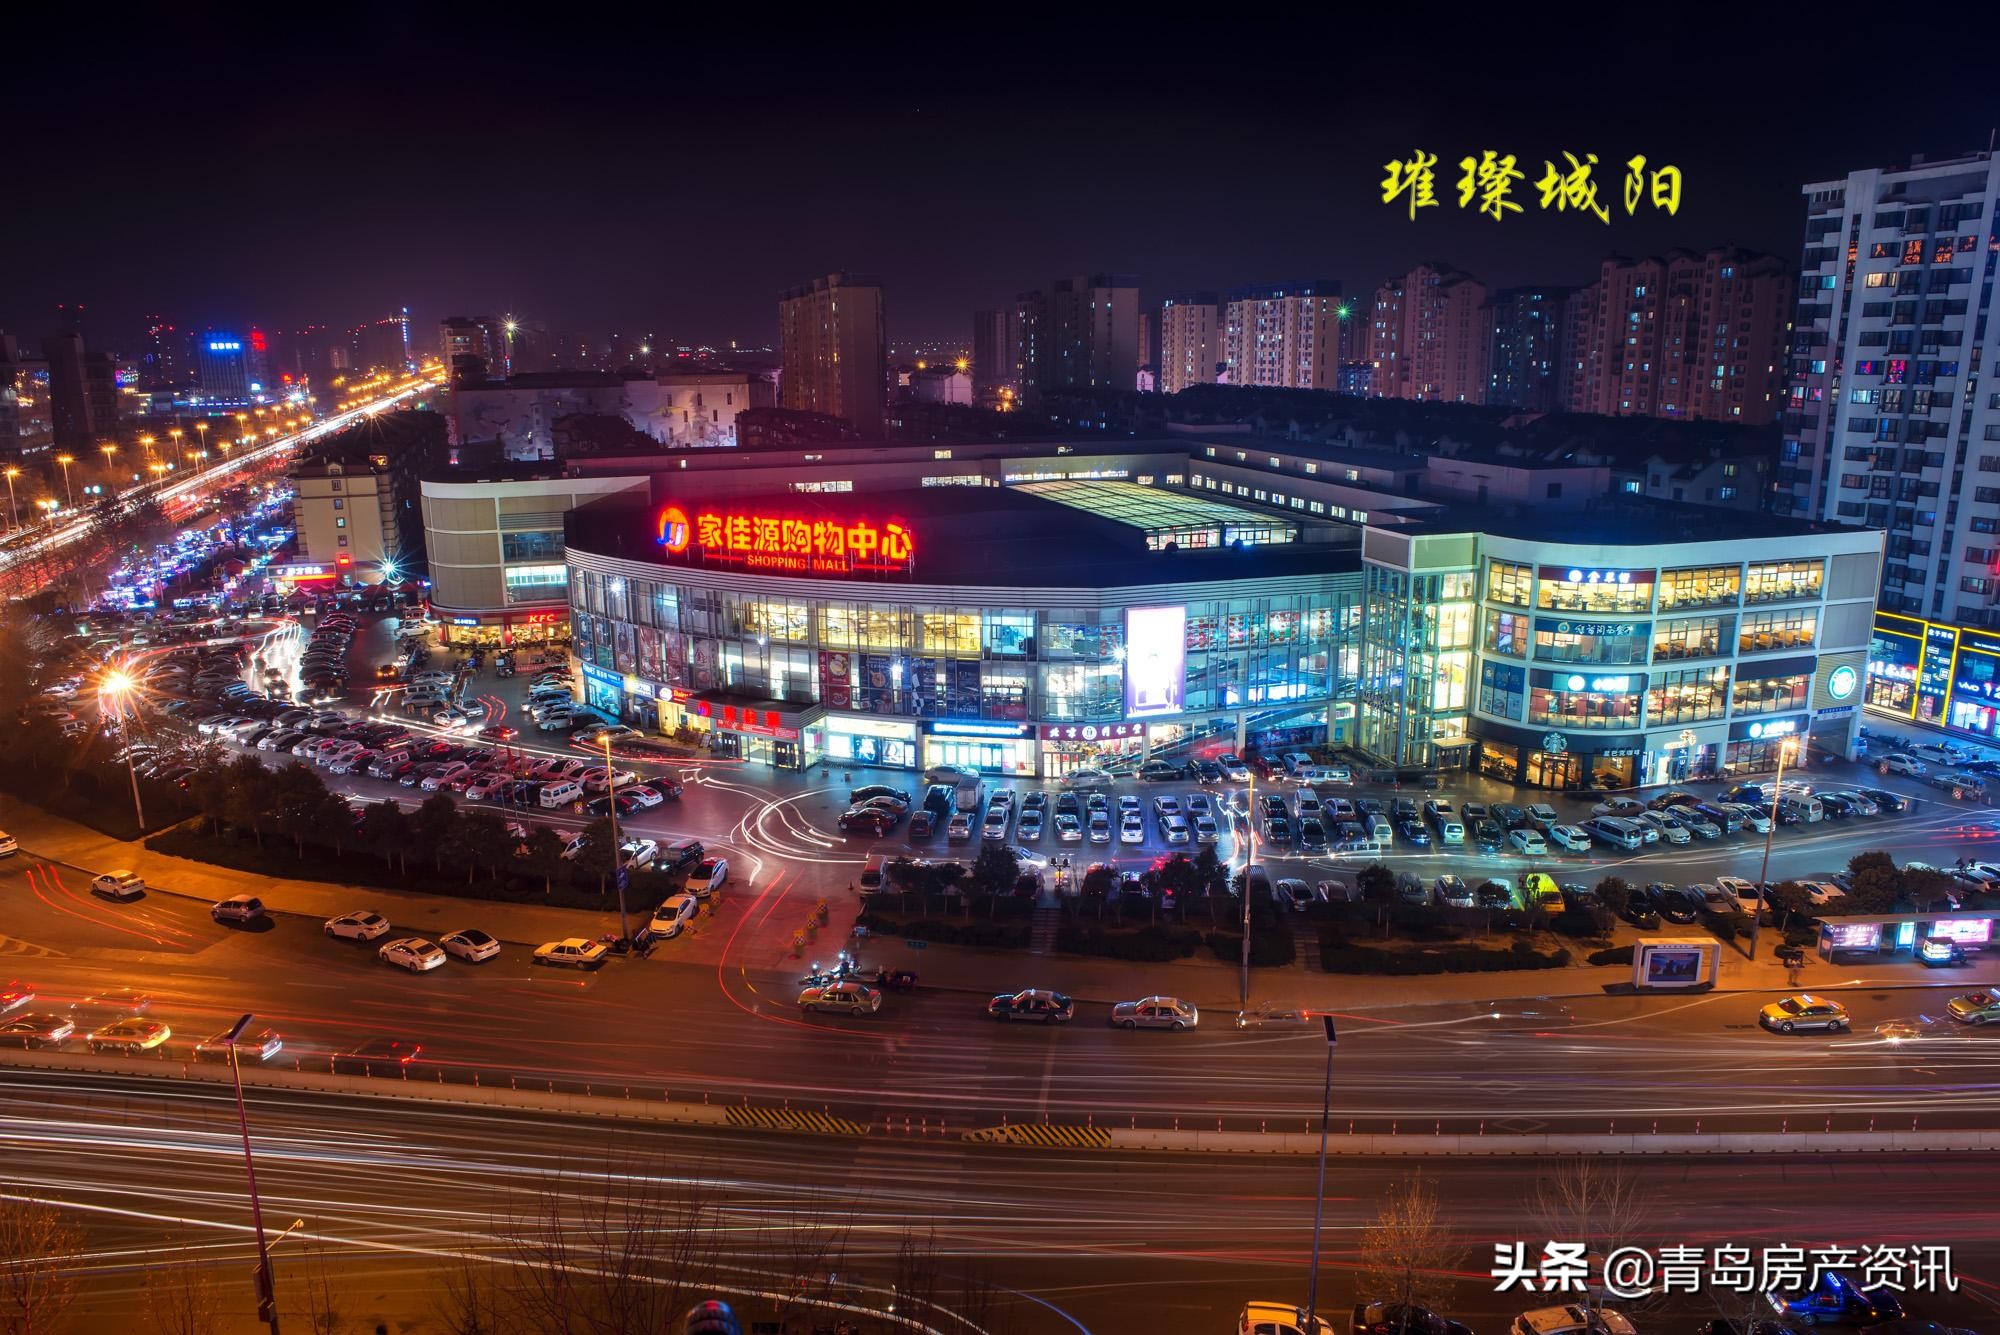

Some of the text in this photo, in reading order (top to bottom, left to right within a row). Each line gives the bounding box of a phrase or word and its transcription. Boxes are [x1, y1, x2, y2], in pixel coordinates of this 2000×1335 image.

[697, 513, 914, 560] 家佳源购物中心
[747, 554, 849, 572] SHOPPING MALL
[528, 613, 556, 624] KFC
[1958, 681, 1980, 692] vivo
